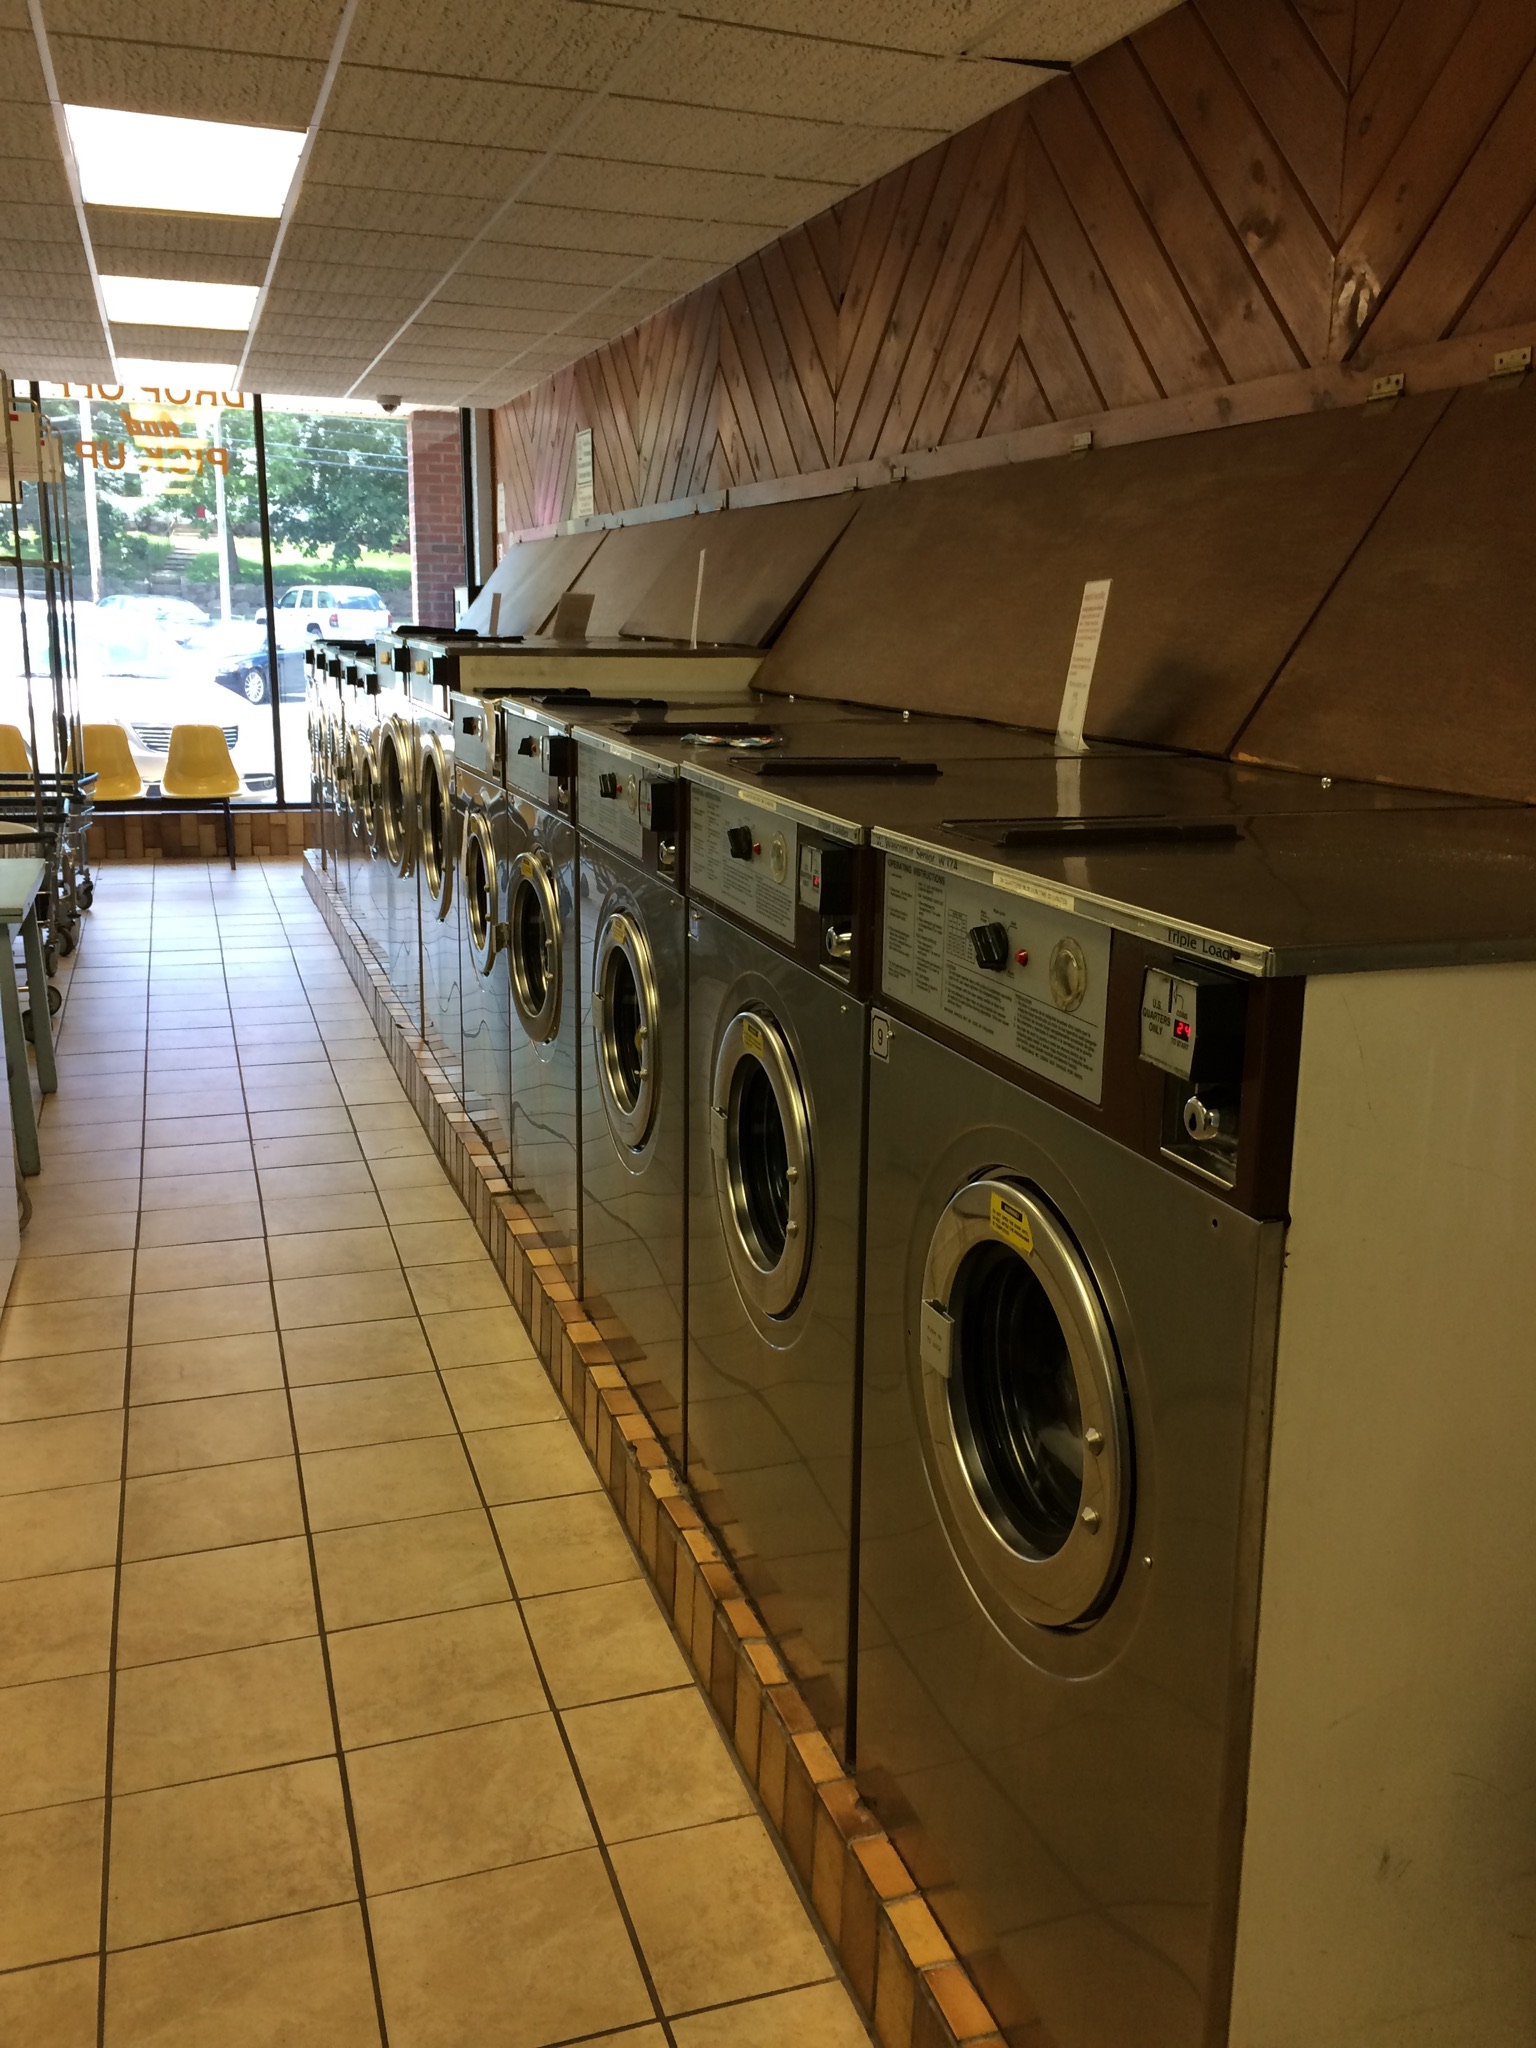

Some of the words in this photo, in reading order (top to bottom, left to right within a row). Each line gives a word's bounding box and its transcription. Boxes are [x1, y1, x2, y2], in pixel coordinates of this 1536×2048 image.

[888, 859, 912, 874] OPERATING
[913, 867, 945, 886] INSTRUCTIONS
[1168, 930, 1197, 950] Triple
[1143, 1007, 1171, 1026] QUARTERS
[878, 1028, 884, 1046] 9
[1148, 1022, 1163, 1036] ONLY
